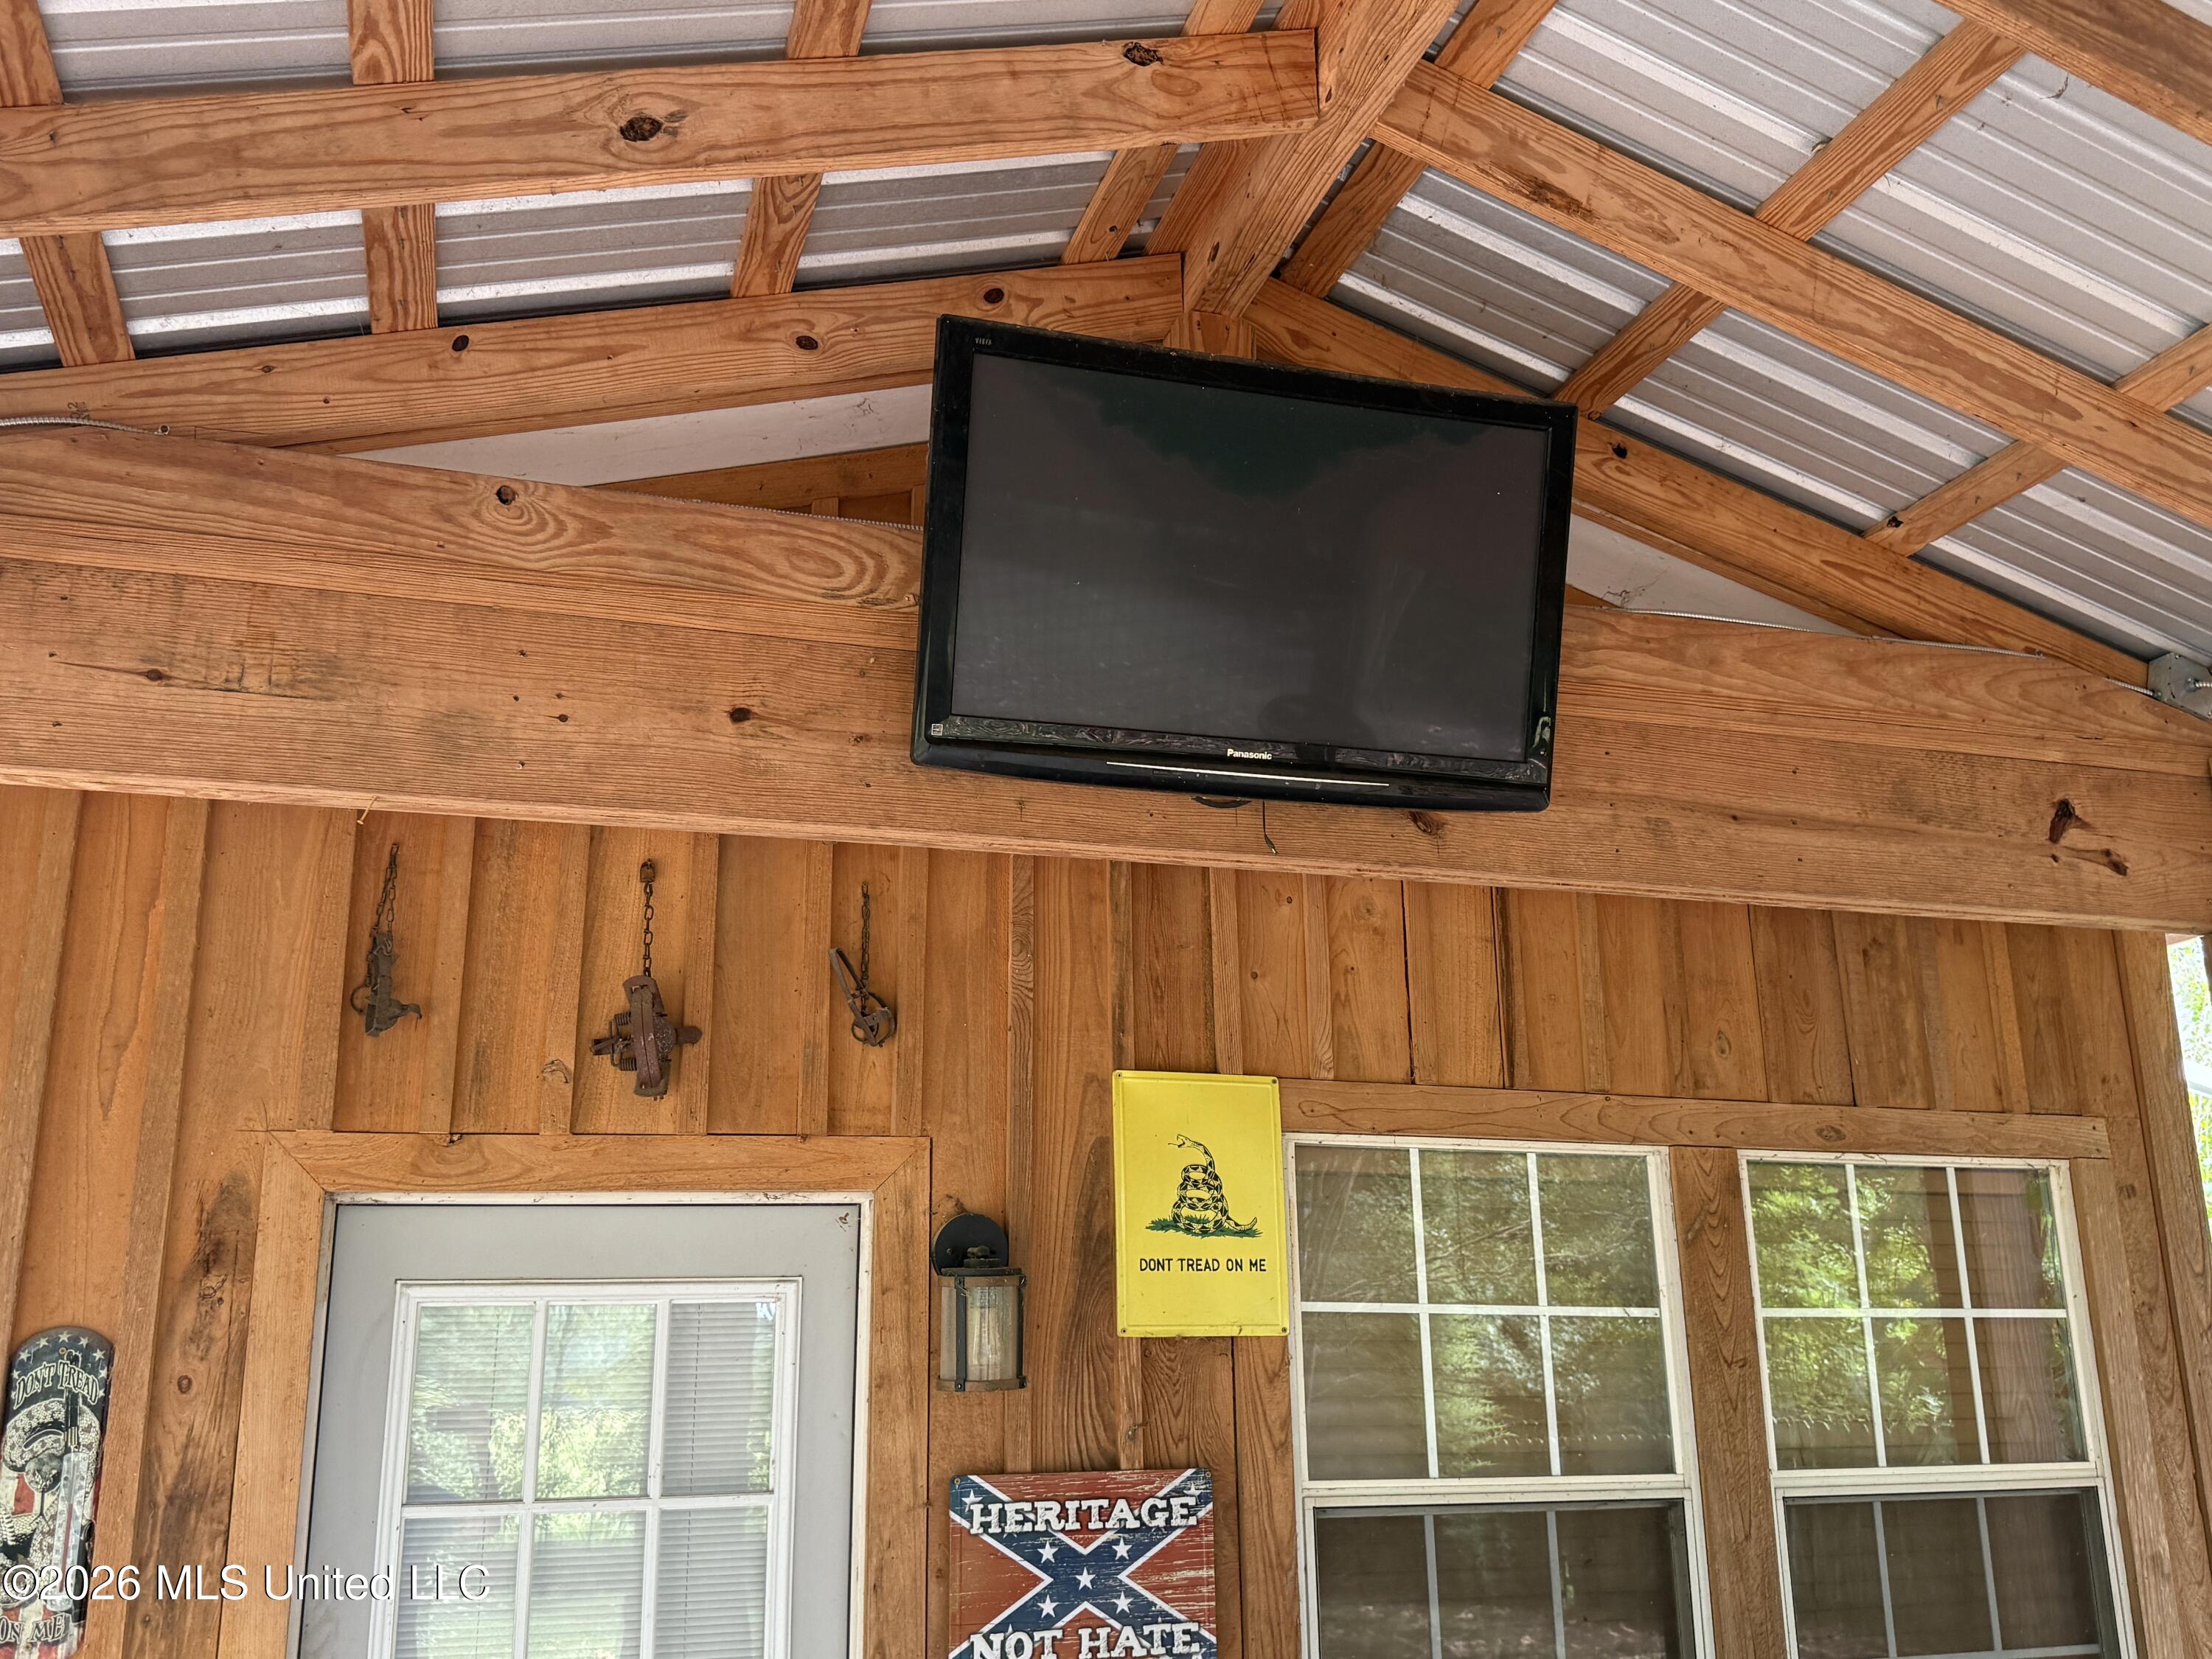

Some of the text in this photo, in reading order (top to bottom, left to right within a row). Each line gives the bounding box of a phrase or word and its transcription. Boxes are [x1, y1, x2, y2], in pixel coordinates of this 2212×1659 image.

[1227, 748, 1273, 760] Panasonic
[1139, 1258, 1267, 1272] DONT TREAD ON ME
[13, 1360, 100, 1410] DON'T TREAD
[970, 1496, 1198, 1534] HERITAGE
[27, 1613, 65, 1642] ME
[970, 1621, 1201, 1659] NOT HATE
